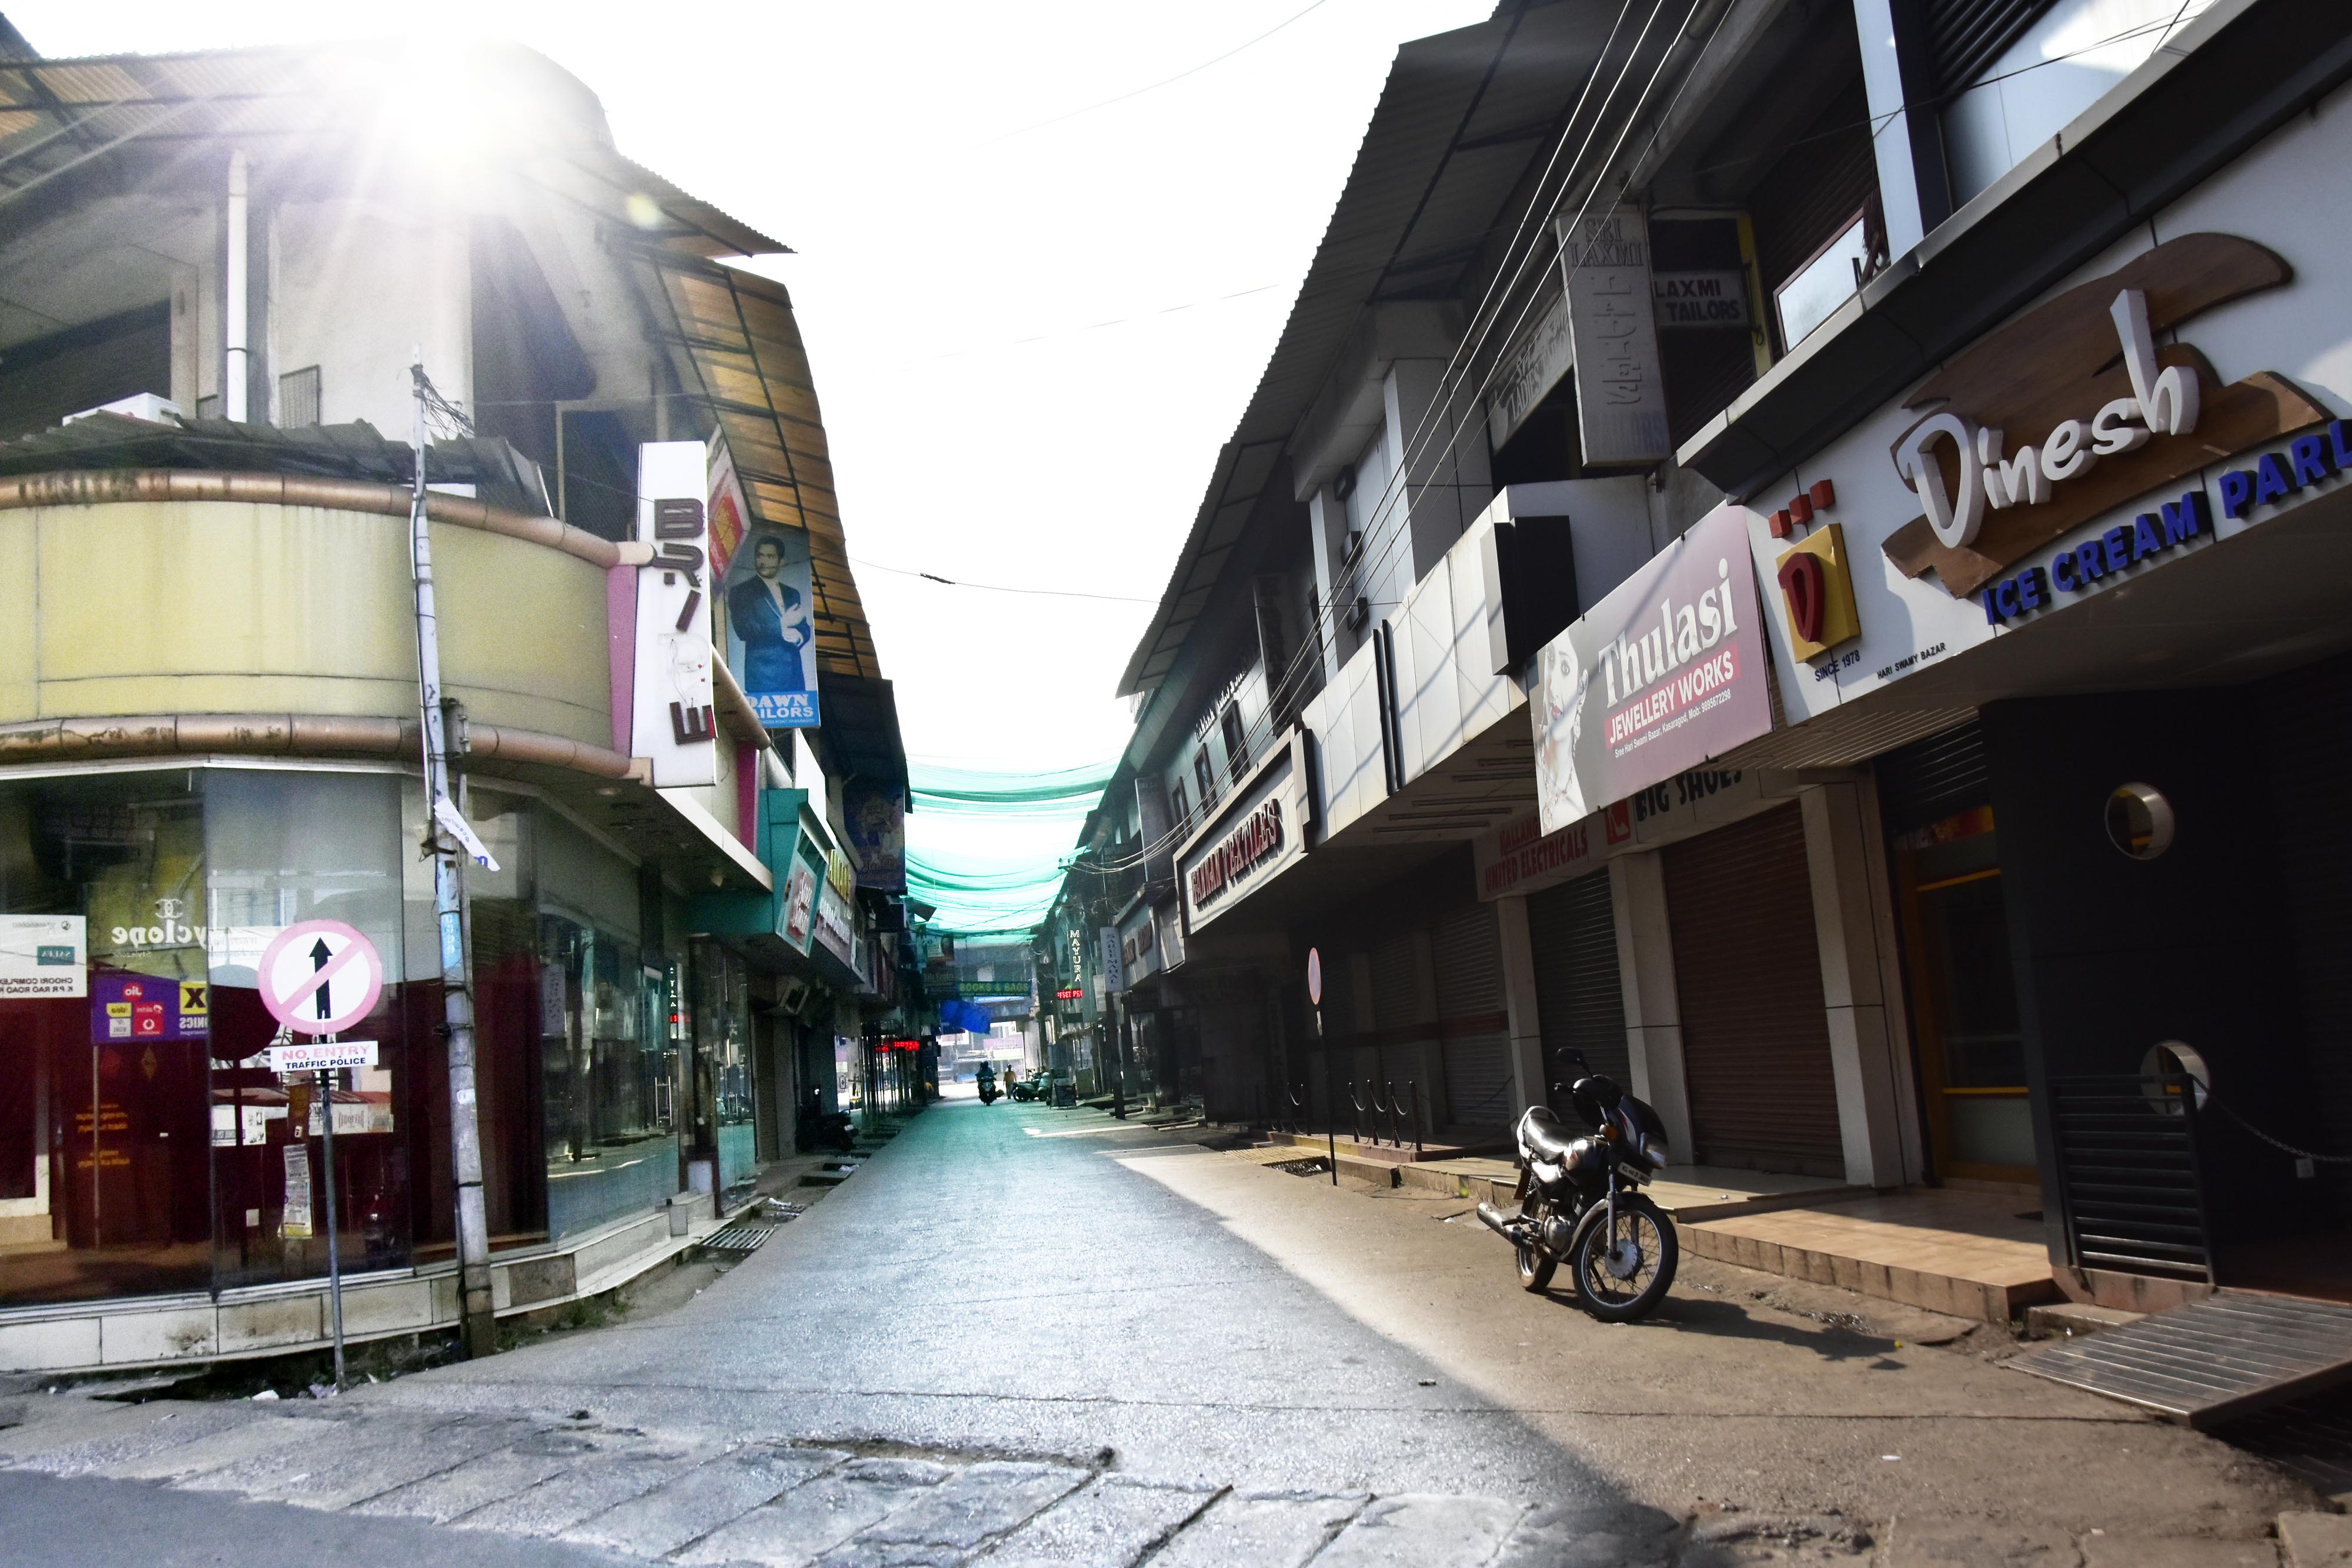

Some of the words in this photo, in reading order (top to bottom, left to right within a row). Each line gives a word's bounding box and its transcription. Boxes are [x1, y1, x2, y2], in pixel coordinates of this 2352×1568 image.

[1584, 218, 1622, 243] SRI
[1571, 241, 1644, 267] LAXMI
[1655, 279, 1721, 299] LAXMI
[1665, 301, 1740, 322] TAILORS
[1896, 289, 2200, 549] Dinesh
[1982, 567, 2049, 626] ICE
[2050, 491, 2211, 593] CREAM
[1598, 557, 1738, 709] Thulasi
[1815, 659, 1840, 681] SINCE
[1842, 650, 1860, 667] 1978
[1876, 666, 1892, 680] HARI
[1895, 654, 1919, 671] SWAMY
[1920, 642, 1947, 660] BAZAR
[746, 694, 809, 708] DAWN
[1609, 682, 1676, 745] JEWELLERY
[1678, 651, 1735, 706] WORKS
[1615, 747, 1625, 758] Sree
[1624, 741, 1633, 751] Hari
[1633, 733, 1648, 748] Swami
[1688, 707, 1701, 720] Mob:
[1635, 784, 1670, 822] BIG
[1222, 798, 1281, 882] TEXTILES
[1485, 859, 1518, 892] UNITED
[1521, 824, 1588, 880] ELECTRICALS
[1070, 930, 1081, 982] MAYURA
[959, 982, 993, 992] BOOKS
[1004, 982, 1029, 992] BAGS
[282, 1049, 307, 1060] NO
[313, 1044, 371, 1058] ENTRY
[285, 1060, 327, 1069] TRAFFIC
[330, 1057, 366, 1066] POLICE
